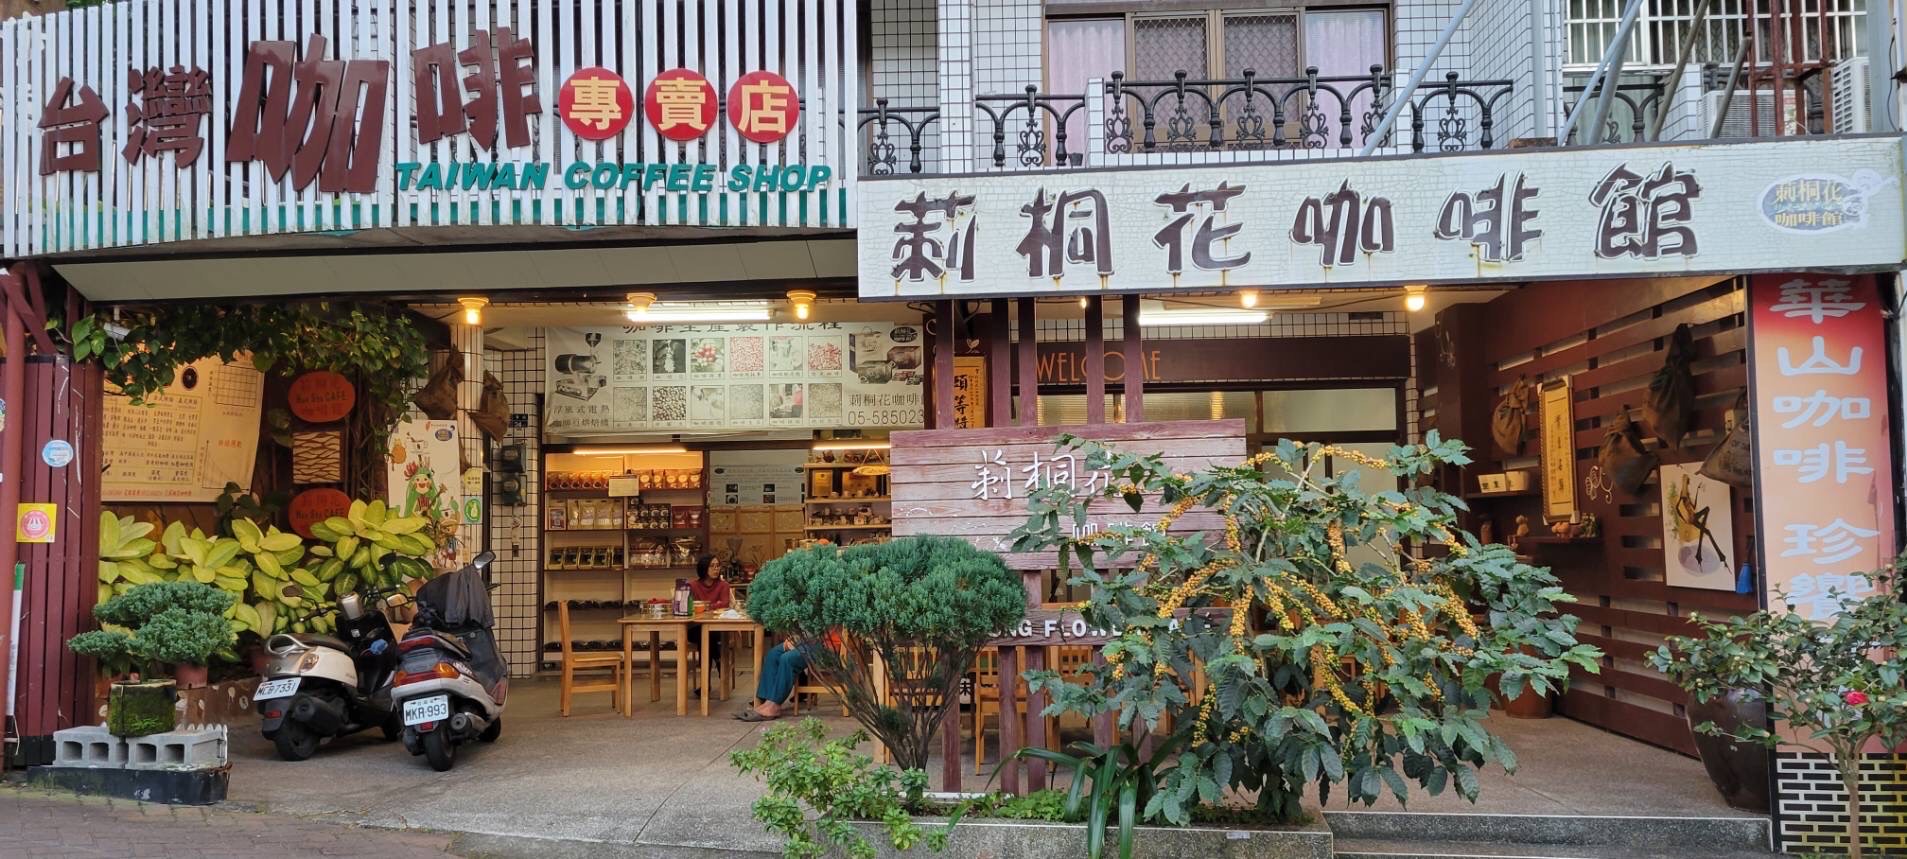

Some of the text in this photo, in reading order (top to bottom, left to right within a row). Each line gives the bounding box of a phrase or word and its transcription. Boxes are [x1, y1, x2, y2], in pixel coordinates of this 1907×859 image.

[396, 161, 832, 192] TAIWAN COFFEE SHOP
[1036, 350, 1161, 382] WELOE
[1769, 279, 1875, 484] 華山咖啡
